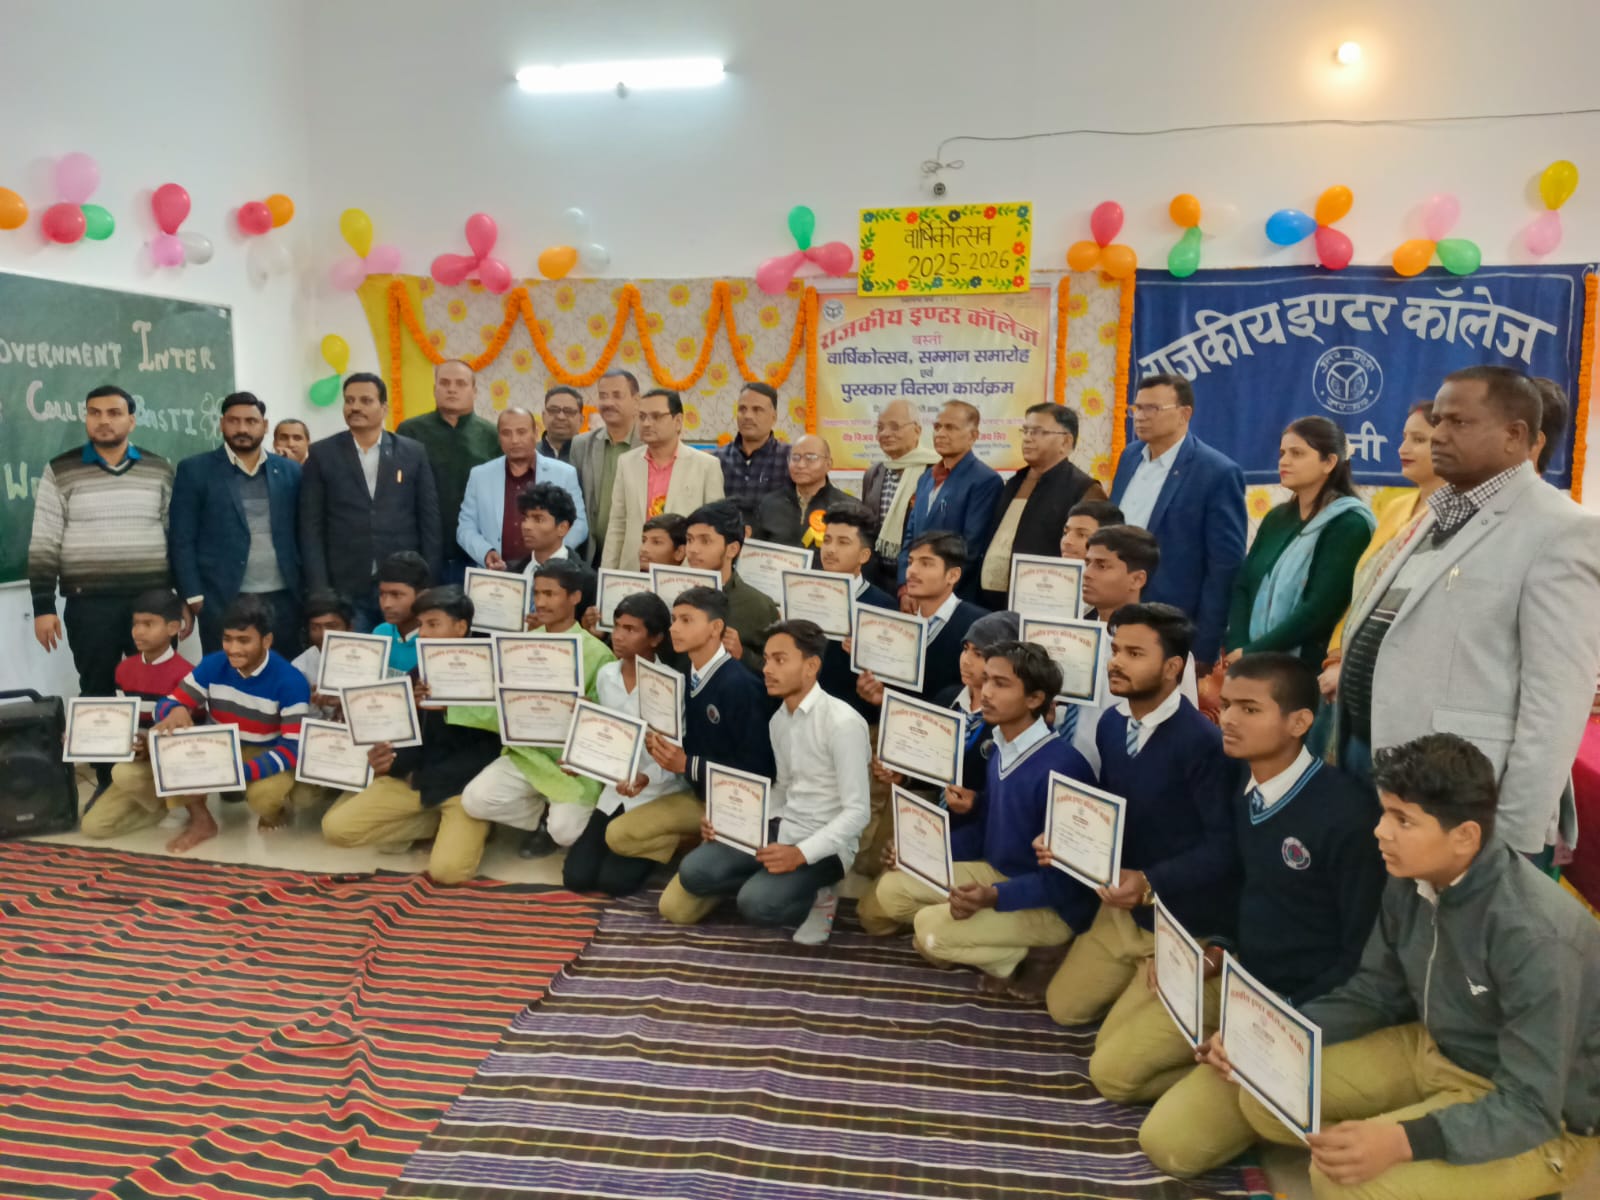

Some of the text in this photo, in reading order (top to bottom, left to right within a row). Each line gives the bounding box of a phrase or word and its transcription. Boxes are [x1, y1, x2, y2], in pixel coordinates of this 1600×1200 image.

[904, 219, 996, 249] वार्षिकोत्सव
[908, 250, 1009, 280] 2025-2026
[820, 306, 1040, 351] राजकीय इण्टर कॉलेज
[912, 332, 943, 346] बस्ती
[1138, 286, 1558, 382] राजकीय इण्टर कॉलेज
[0, 336, 122, 369] OVERNMENT
[918, 350, 970, 364] सम्मान
[974, 344, 1030, 364] समारोह
[920, 366, 934, 378] एवं
[841, 377, 1015, 403] पुरस्कार वितरण कार्यक्रम
